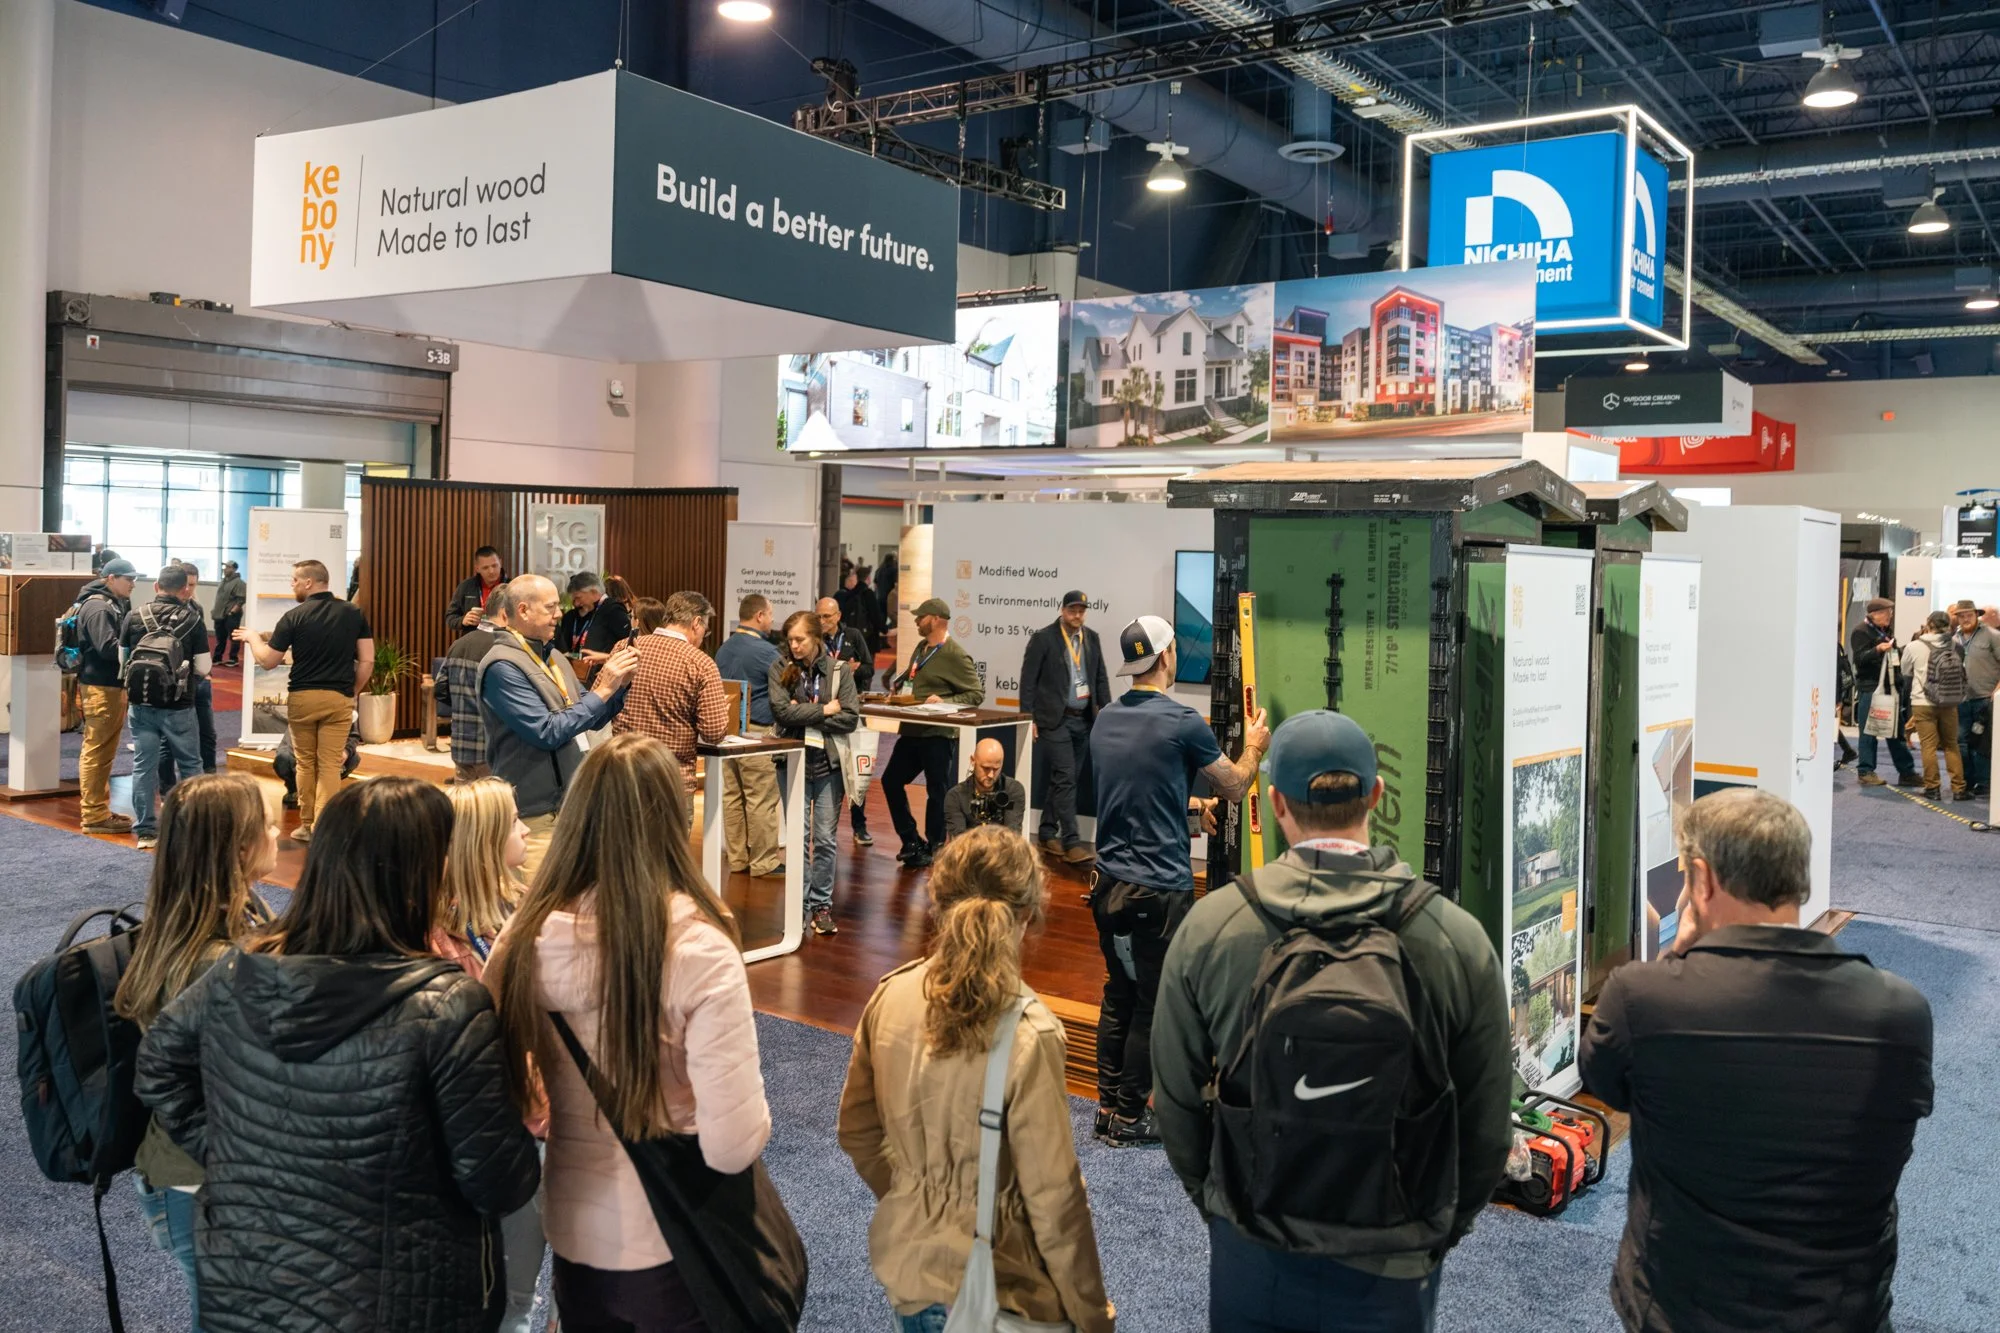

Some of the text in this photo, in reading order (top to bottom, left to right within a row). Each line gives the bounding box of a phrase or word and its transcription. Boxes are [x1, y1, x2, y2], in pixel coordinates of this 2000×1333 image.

[304, 161, 340, 198] ke
[380, 162, 546, 216] Natural wood
[302, 197, 337, 232] bo
[656, 163, 935, 272] Build a better future.
[377, 211, 531, 257] Made to last
[300, 231, 335, 270] ny
[1464, 239, 1573, 265] NICHIHA
[427, 350, 451, 365] S-3B
[1623, 395, 1652, 403] OUTDOOR
[773, 569, 796, 578] badge
[978, 565, 1058, 578] Modified Wood
[1386, 543, 1401, 631] STRUCTURAL
[978, 594, 1063, 611] Environmentally
[977, 623, 991, 636] Up
[994, 624, 1005, 635] to
[1007, 625, 1020, 636] 35
[1364, 609, 1375, 691] WATER-RESISTIVE
[1512, 655, 1550, 668] Natural wood
[995, 676, 1019, 691] keb
